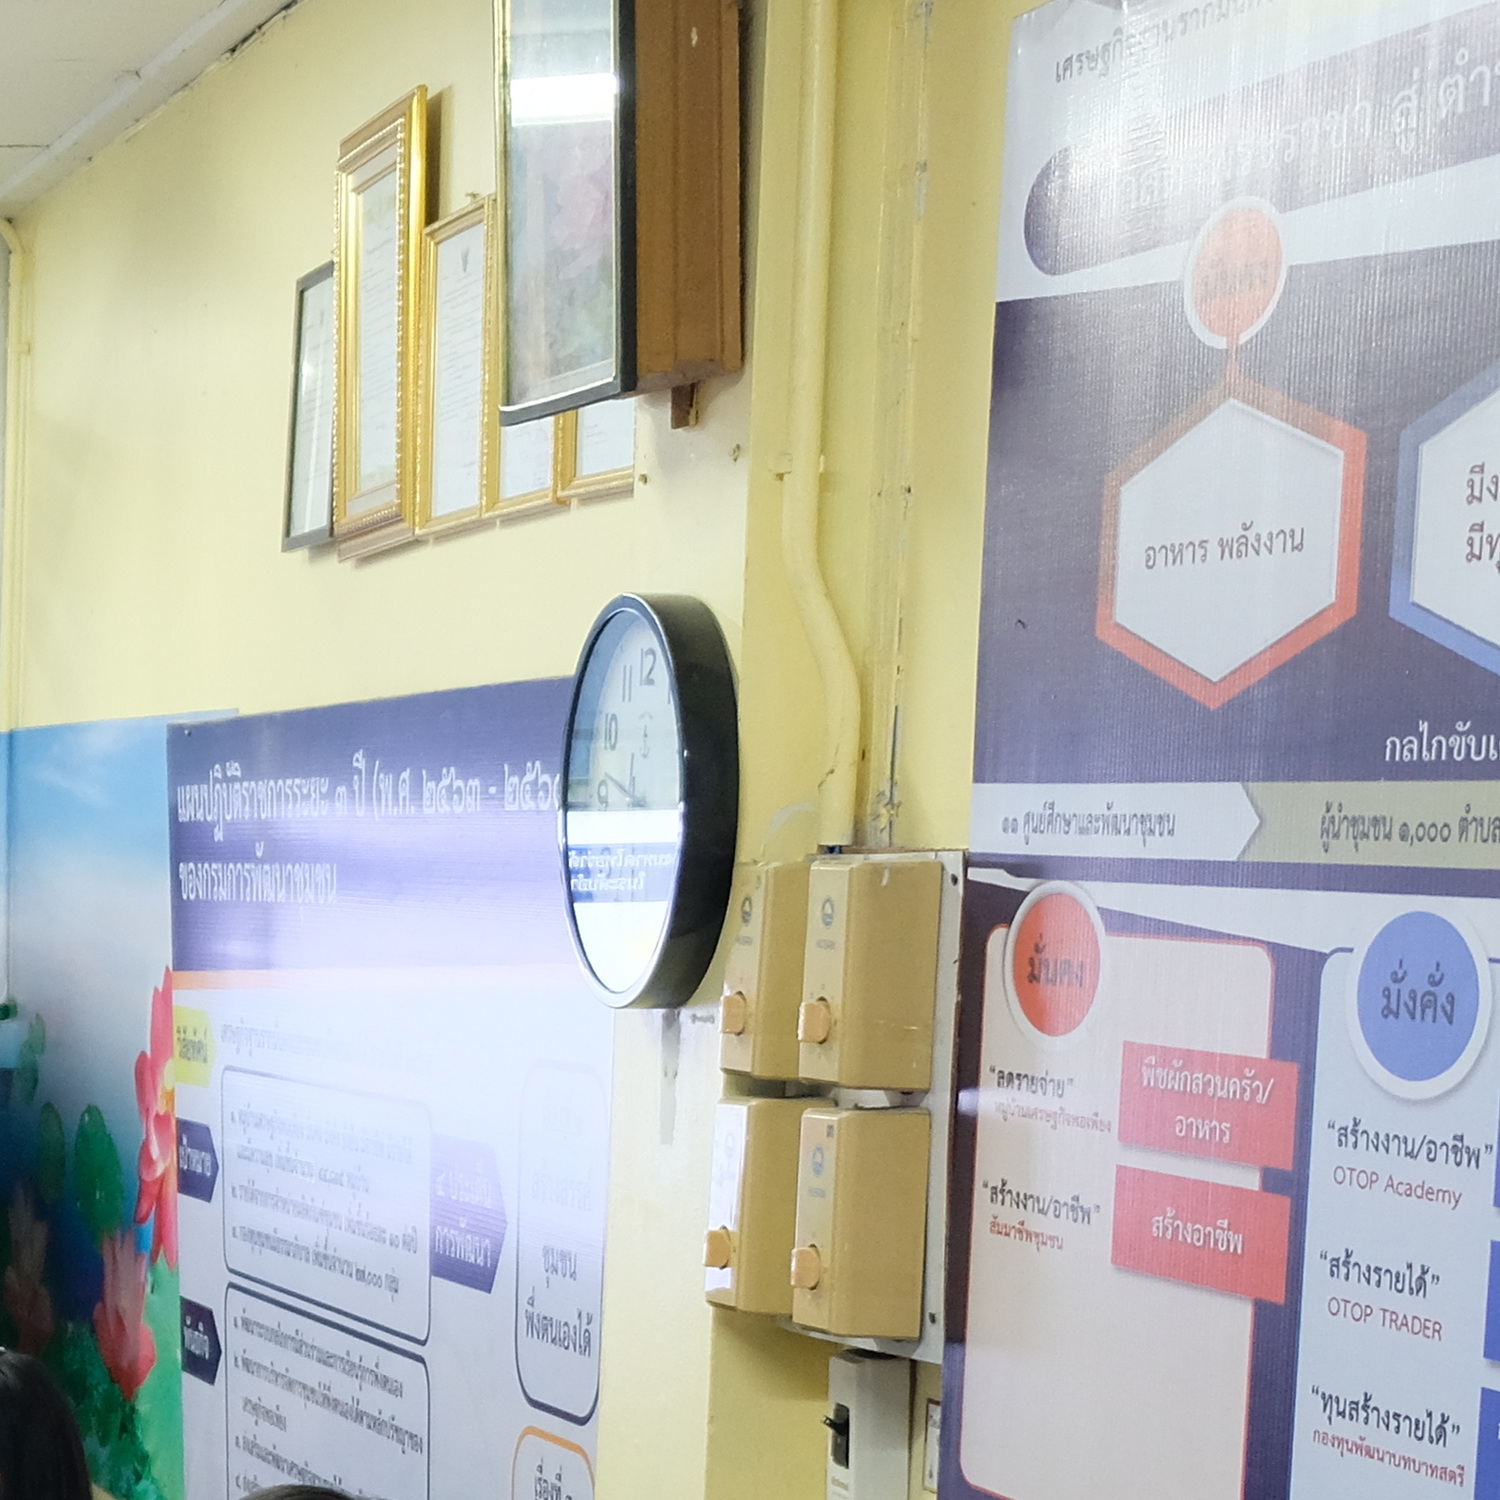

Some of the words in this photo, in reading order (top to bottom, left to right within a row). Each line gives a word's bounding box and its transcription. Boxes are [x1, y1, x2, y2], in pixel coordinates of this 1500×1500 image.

[1437, 46, 1500, 118] ตำ
[1143, 533, 1209, 570] อาหาร
[1216, 521, 1305, 563] พลังงาน
[621, 664, 634, 704] 11
[639, 647, 658, 686] 12
[604, 712, 619, 752] 10
[178, 760, 329, 842] แผนปฏิบัติราชการระยะ
[352, 748, 367, 816] ปี
[422, 766, 481, 815] ๒๕๖๓
[596, 780, 610, 811] 9
[1022, 801, 1177, 847] ศูนย์ศึกษาและพัฒนาชุมชน
[1320, 805, 1394, 854] ผู้นำชุมชน
[1397, 819, 1452, 846] ๑,๐๐๐
[1381, 958, 1457, 1027] มั่งคั่ง
[1141, 1055, 1275, 1106] พืชผักสวนครัว/
[1175, 1116, 1231, 1144] อาหาร
[1327, 1117, 1494, 1171] “สร้างงาน/อาชีพ”
[1332, 1165, 1379, 1192] OTOP
[1384, 1173, 1463, 1211] Academy
[434, 1217, 491, 1268] การพัฒนา
[989, 1217, 1064, 1253] สัมมาชีพชุมชน
[1151, 1209, 1244, 1256] สร้างอาชีพ
[542, 1245, 577, 1289] ชุมชน
[1319, 1249, 1441, 1301] “สร้างรายได้”
[524, 1287, 593, 1359] พึ่งตนเองได้
[1327, 1296, 1374, 1325] OTOP
[1379, 1307, 1443, 1342] TRADER
[1310, 1384, 1461, 1449] “ทุนสร้างรายได้”
[1312, 1428, 1466, 1487] กองทุนพัฒนาบทบาทสตรี
